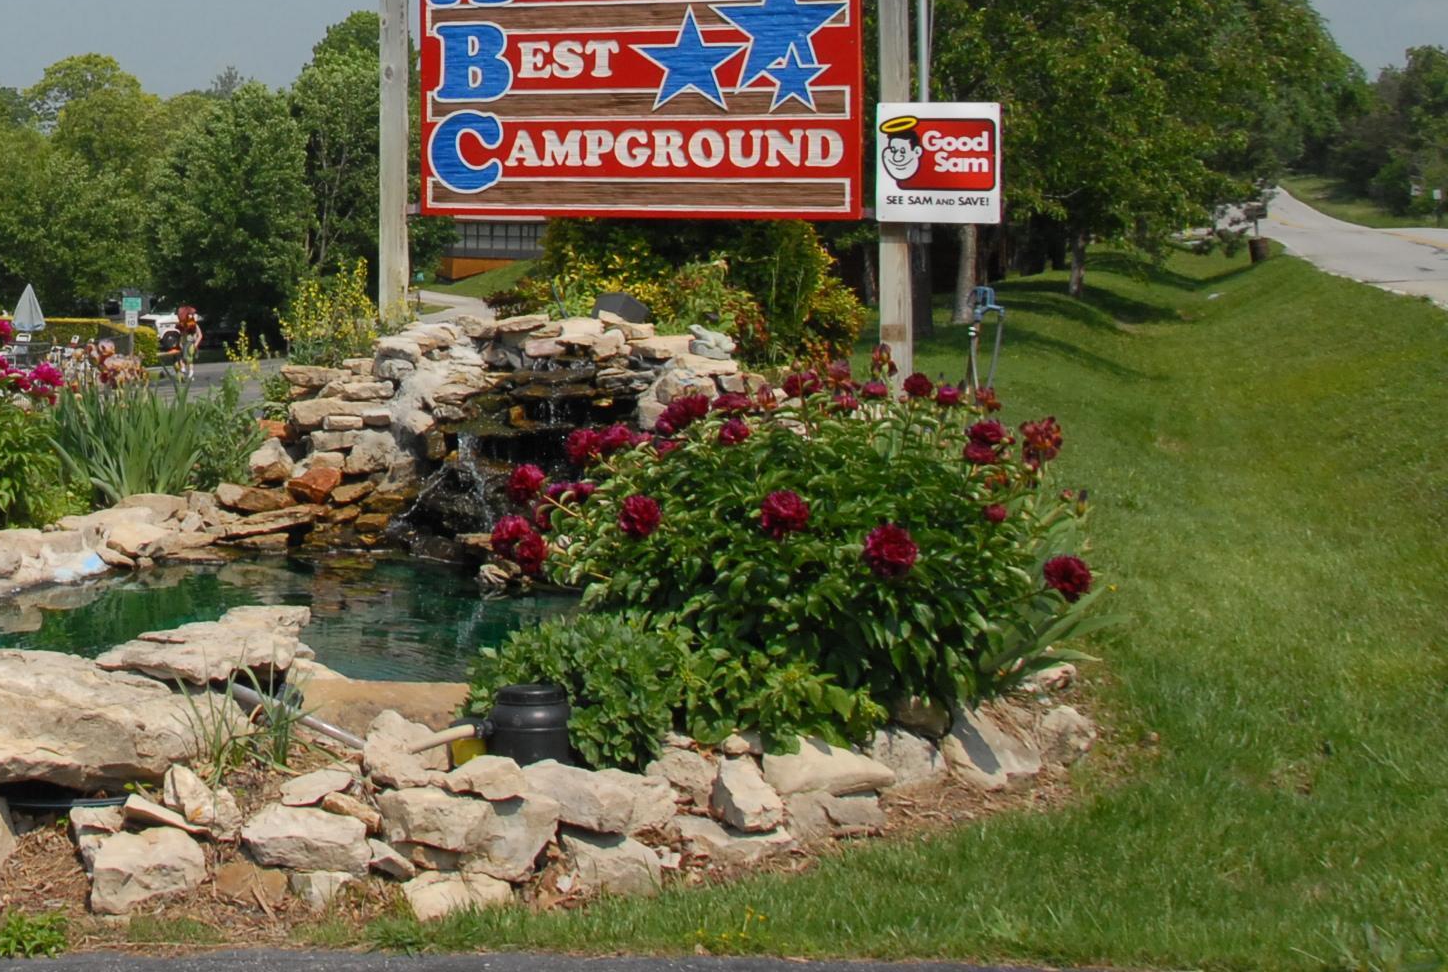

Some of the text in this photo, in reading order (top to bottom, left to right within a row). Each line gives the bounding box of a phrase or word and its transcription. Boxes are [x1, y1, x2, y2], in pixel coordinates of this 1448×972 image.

[432, 21, 621, 103] BEST
[427, 109, 845, 194] CAMPGROUND
[922, 130, 989, 152] Good
[934, 151, 989, 173] Sam
[886, 195, 990, 207] SEE SAM AND SAVE!
